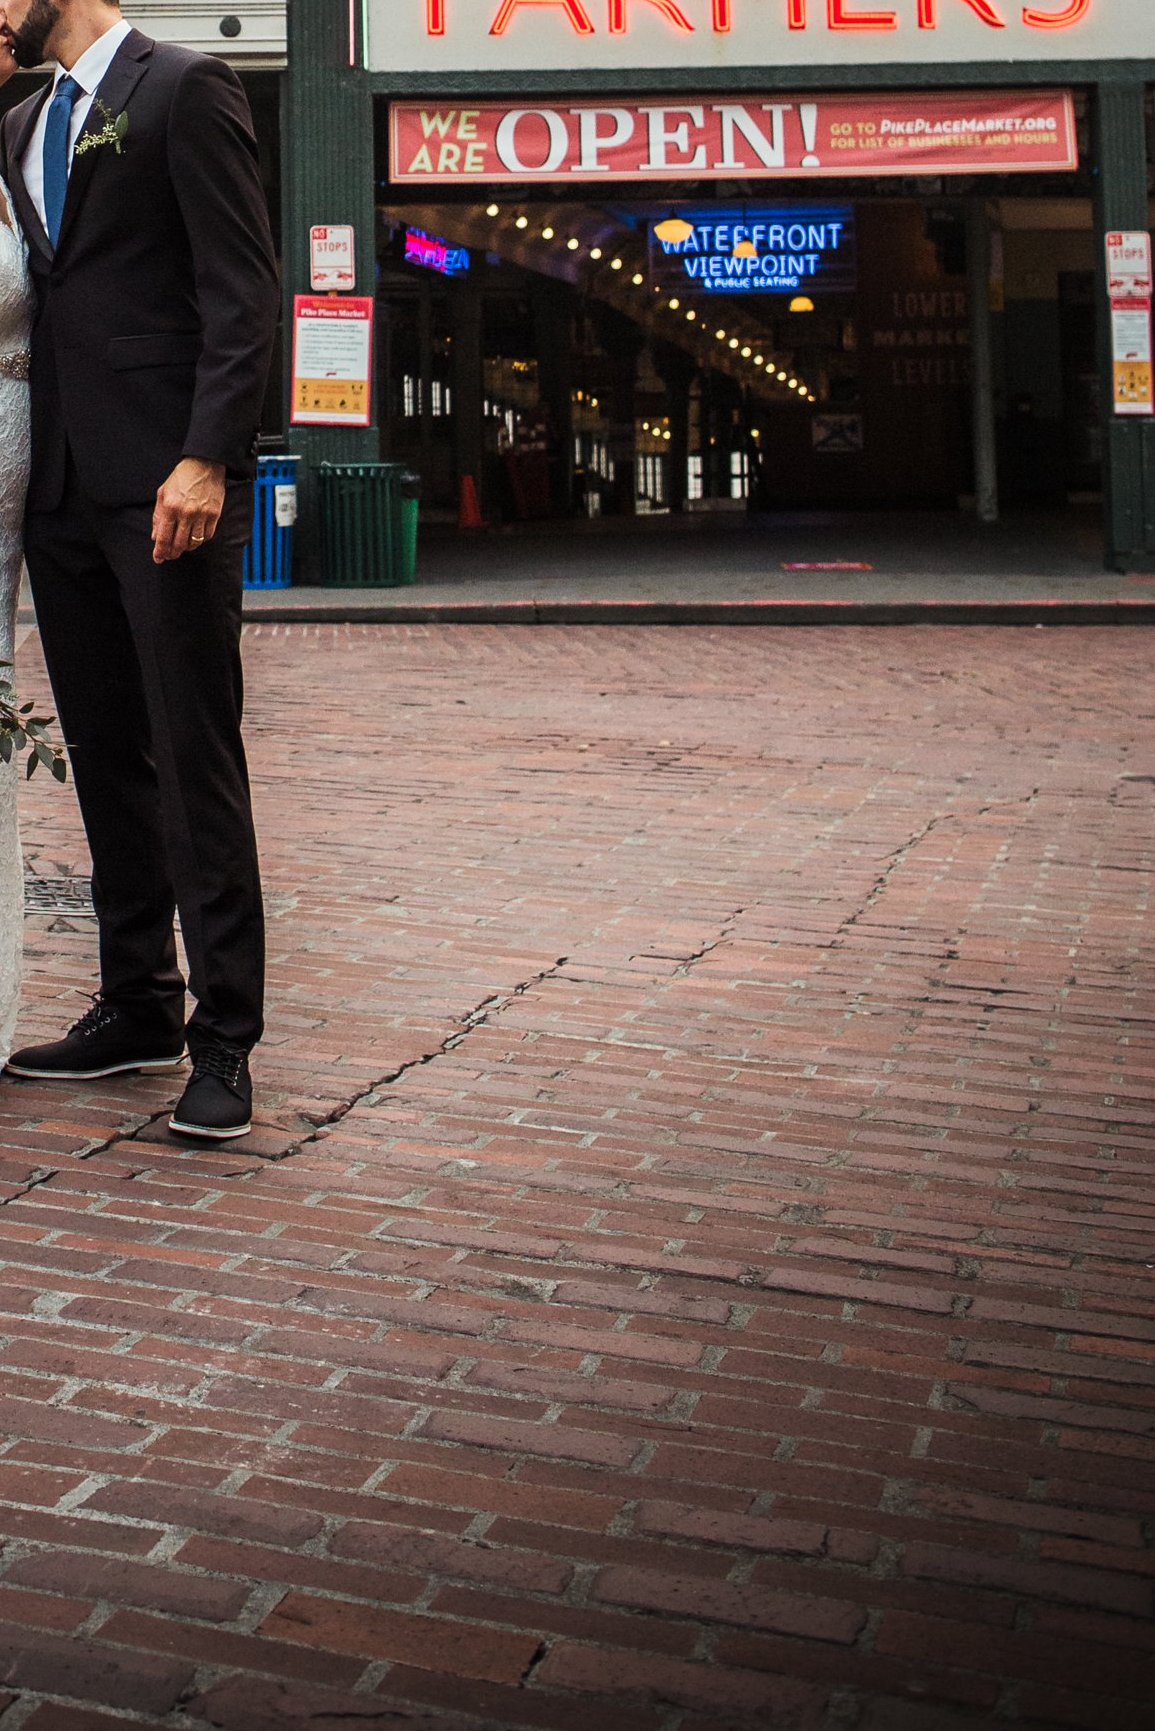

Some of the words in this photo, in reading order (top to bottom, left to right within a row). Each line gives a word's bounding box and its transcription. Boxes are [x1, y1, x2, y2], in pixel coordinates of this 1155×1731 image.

[420, 110, 480, 138] WE
[830, 123, 852, 135] GO
[857, 123, 876, 135] TO
[495, 102, 821, 174] OPEN!
[830, 138, 855, 149] FOR
[859, 137, 883, 148] LIST
[888, 136, 904, 148] OF
[908, 134, 982, 147] BUSINESSES
[985, 134, 1010, 145] AND
[1014, 132, 1058, 144] HOURS
[406, 142, 485, 173] ARE
[312, 228, 326, 239] NO
[317, 241, 348, 252] STOPS
[1112, 247, 1144, 260] STOPS
[684, 254, 820, 278] VIEWPOINT
[714, 277, 751, 289] PUBLIC
[753, 276, 799, 287] SEATING
[301, 308, 317, 316] Pike
[318, 308, 337, 317] Place
[339, 309, 365, 317] Market
